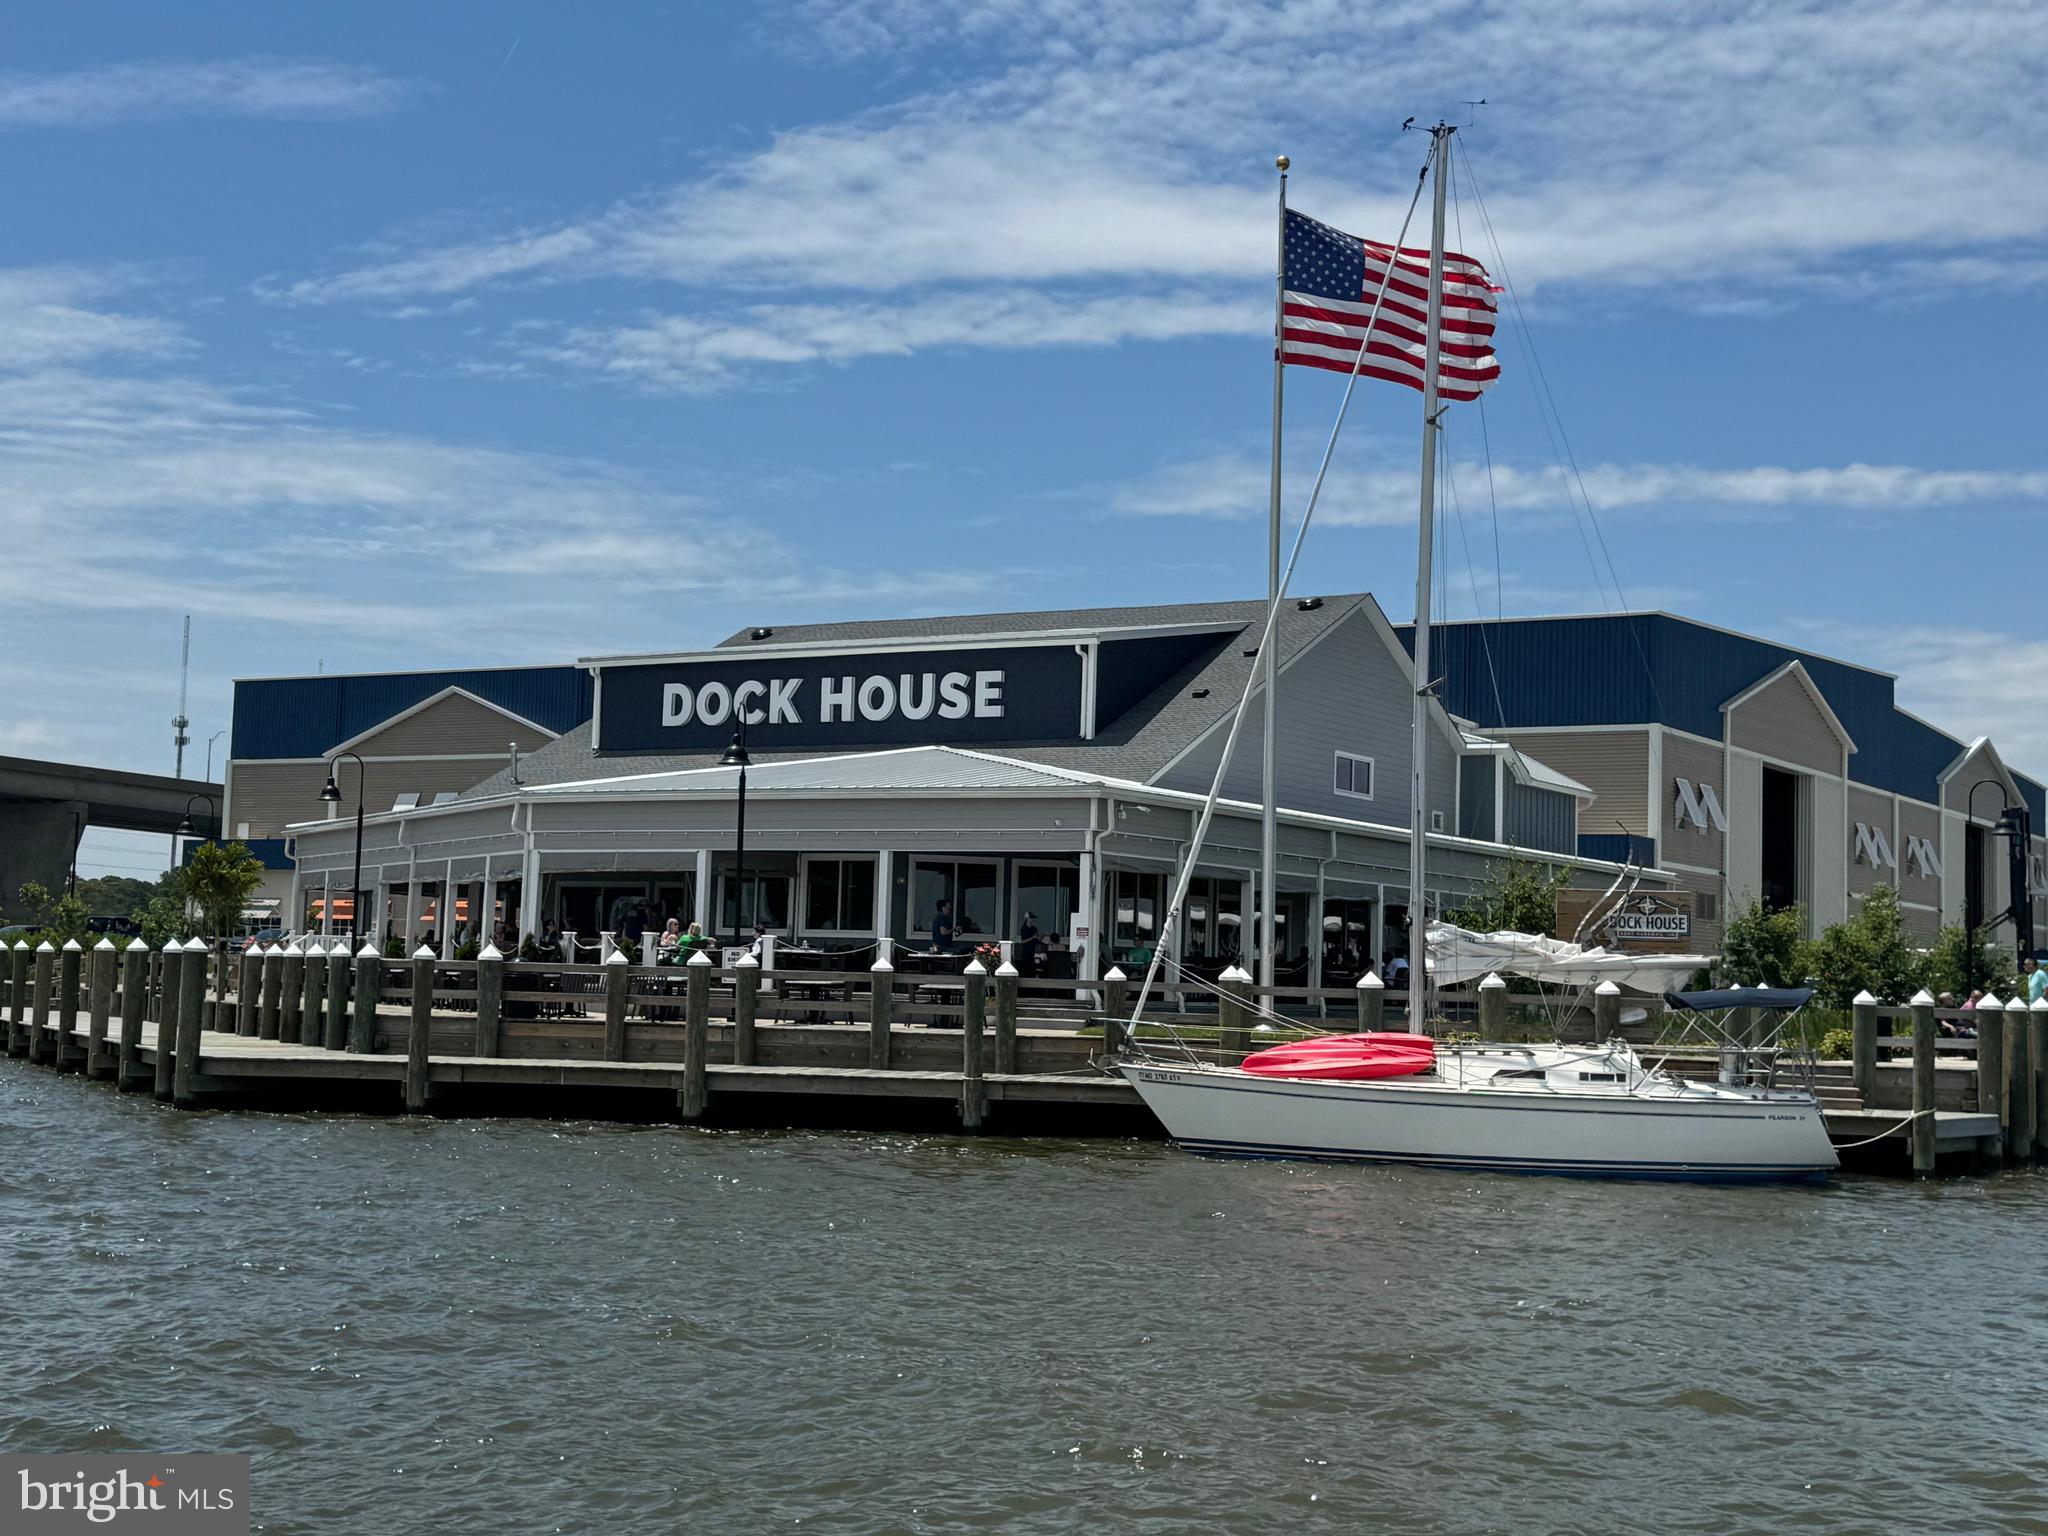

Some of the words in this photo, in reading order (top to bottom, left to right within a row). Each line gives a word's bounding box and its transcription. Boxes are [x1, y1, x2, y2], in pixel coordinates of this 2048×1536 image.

[662, 678, 804, 727] DOCK
[820, 670, 1005, 723] HOUSE
[1608, 915, 1642, 929] DOCK
[1646, 916, 1686, 930] HOUSE
